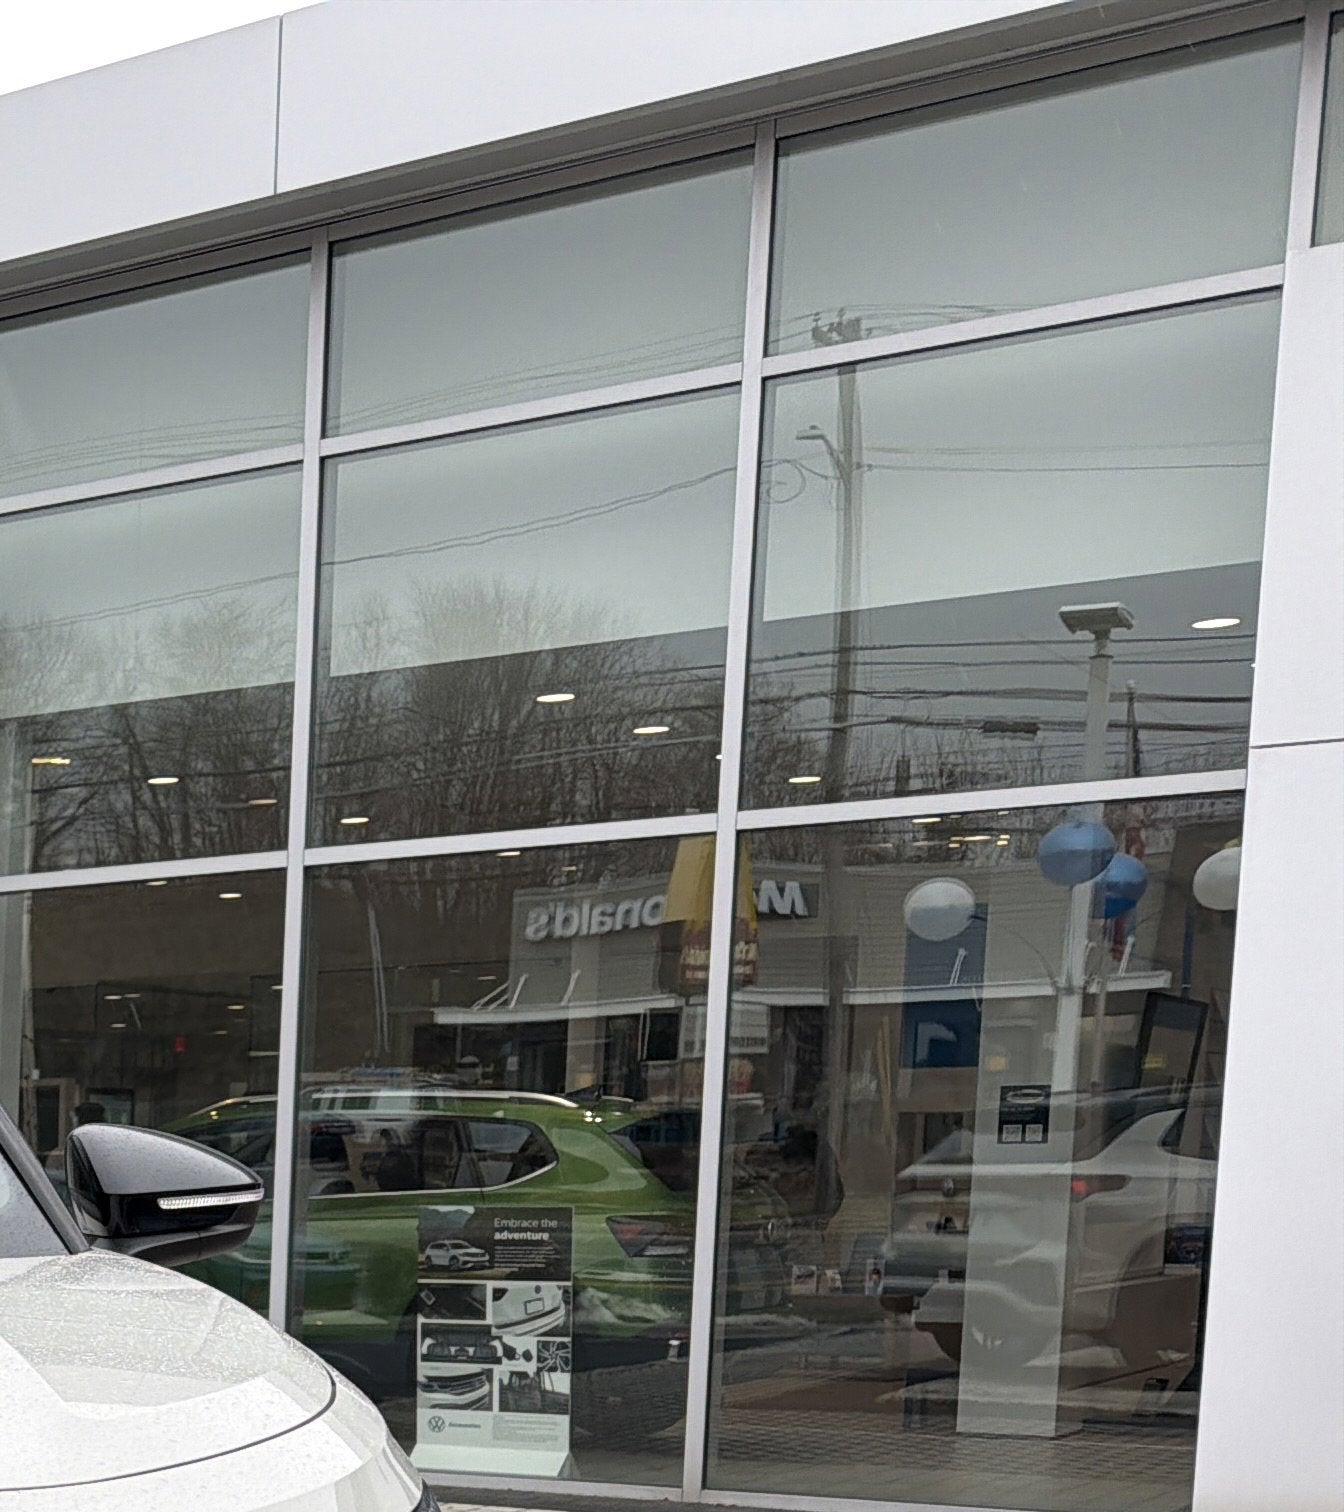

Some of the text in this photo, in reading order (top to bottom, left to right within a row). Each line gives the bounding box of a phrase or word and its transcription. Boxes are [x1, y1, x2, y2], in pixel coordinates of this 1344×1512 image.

[493, 1217, 558, 1229] Embrace the
[493, 1230, 549, 1241] adventure
